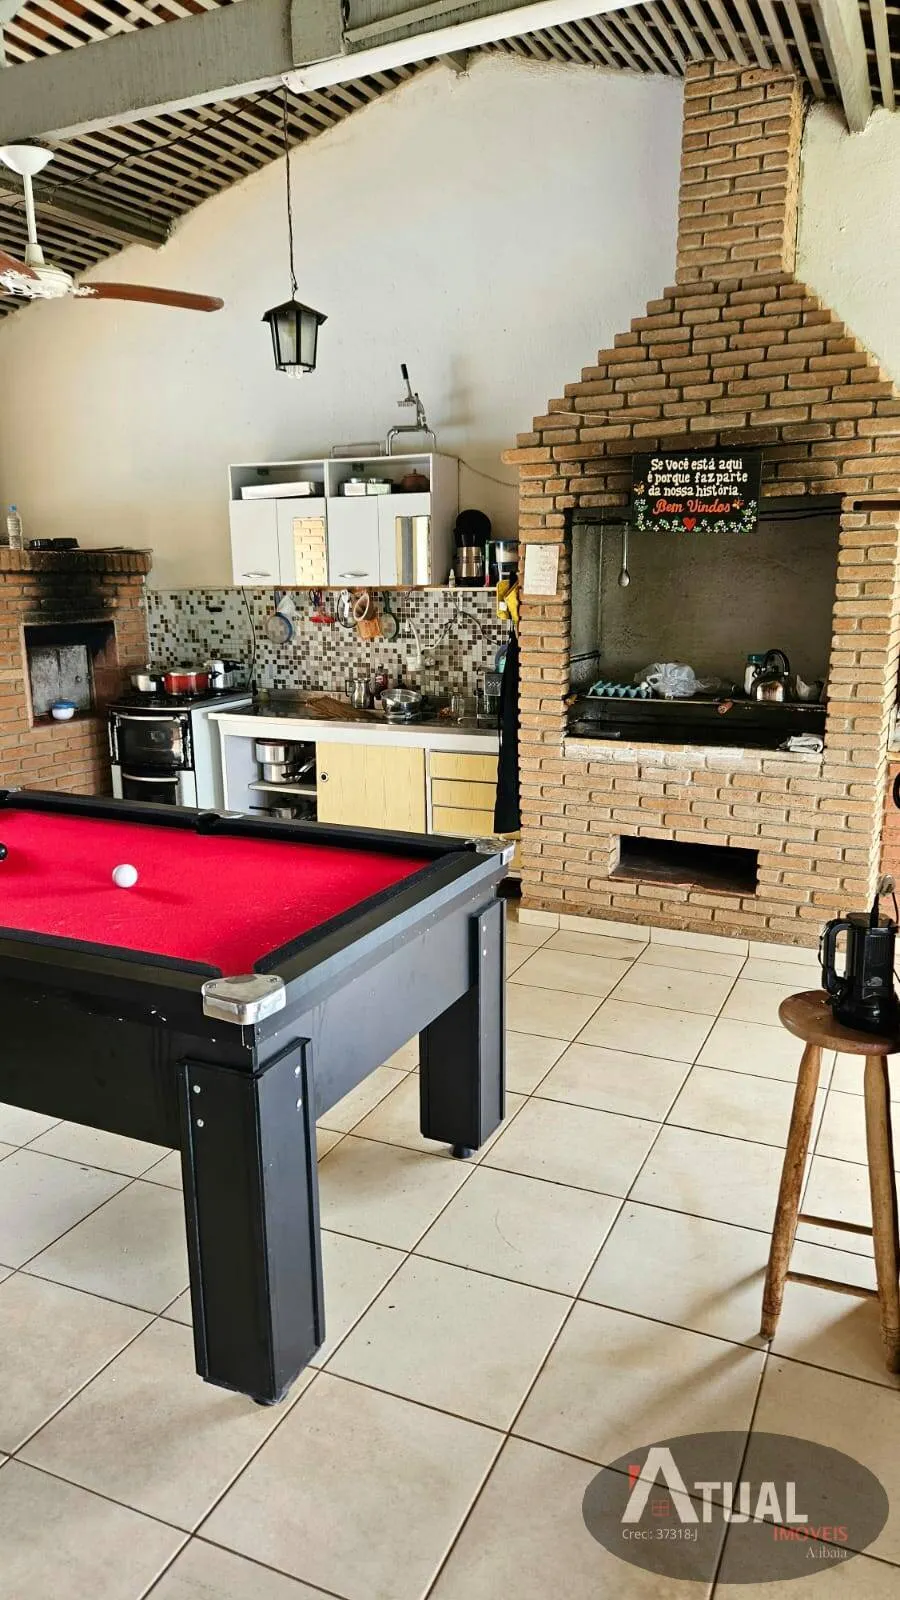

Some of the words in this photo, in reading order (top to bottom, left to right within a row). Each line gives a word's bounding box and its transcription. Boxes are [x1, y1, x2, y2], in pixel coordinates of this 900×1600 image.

[651, 458, 663, 471] Se
[691, 458, 715, 470] está
[718, 458, 743, 472] aqui
[647, 471, 652, 482] é
[655, 473, 690, 485] porque
[694, 471, 715, 483] faz
[716, 471, 748, 485] parte
[648, 485, 661, 496] da
[663, 487, 694, 496] nossa
[695, 484, 743, 497] história.
[652, 499, 684, 515] Bem
[687, 499, 731, 513] Vindos
